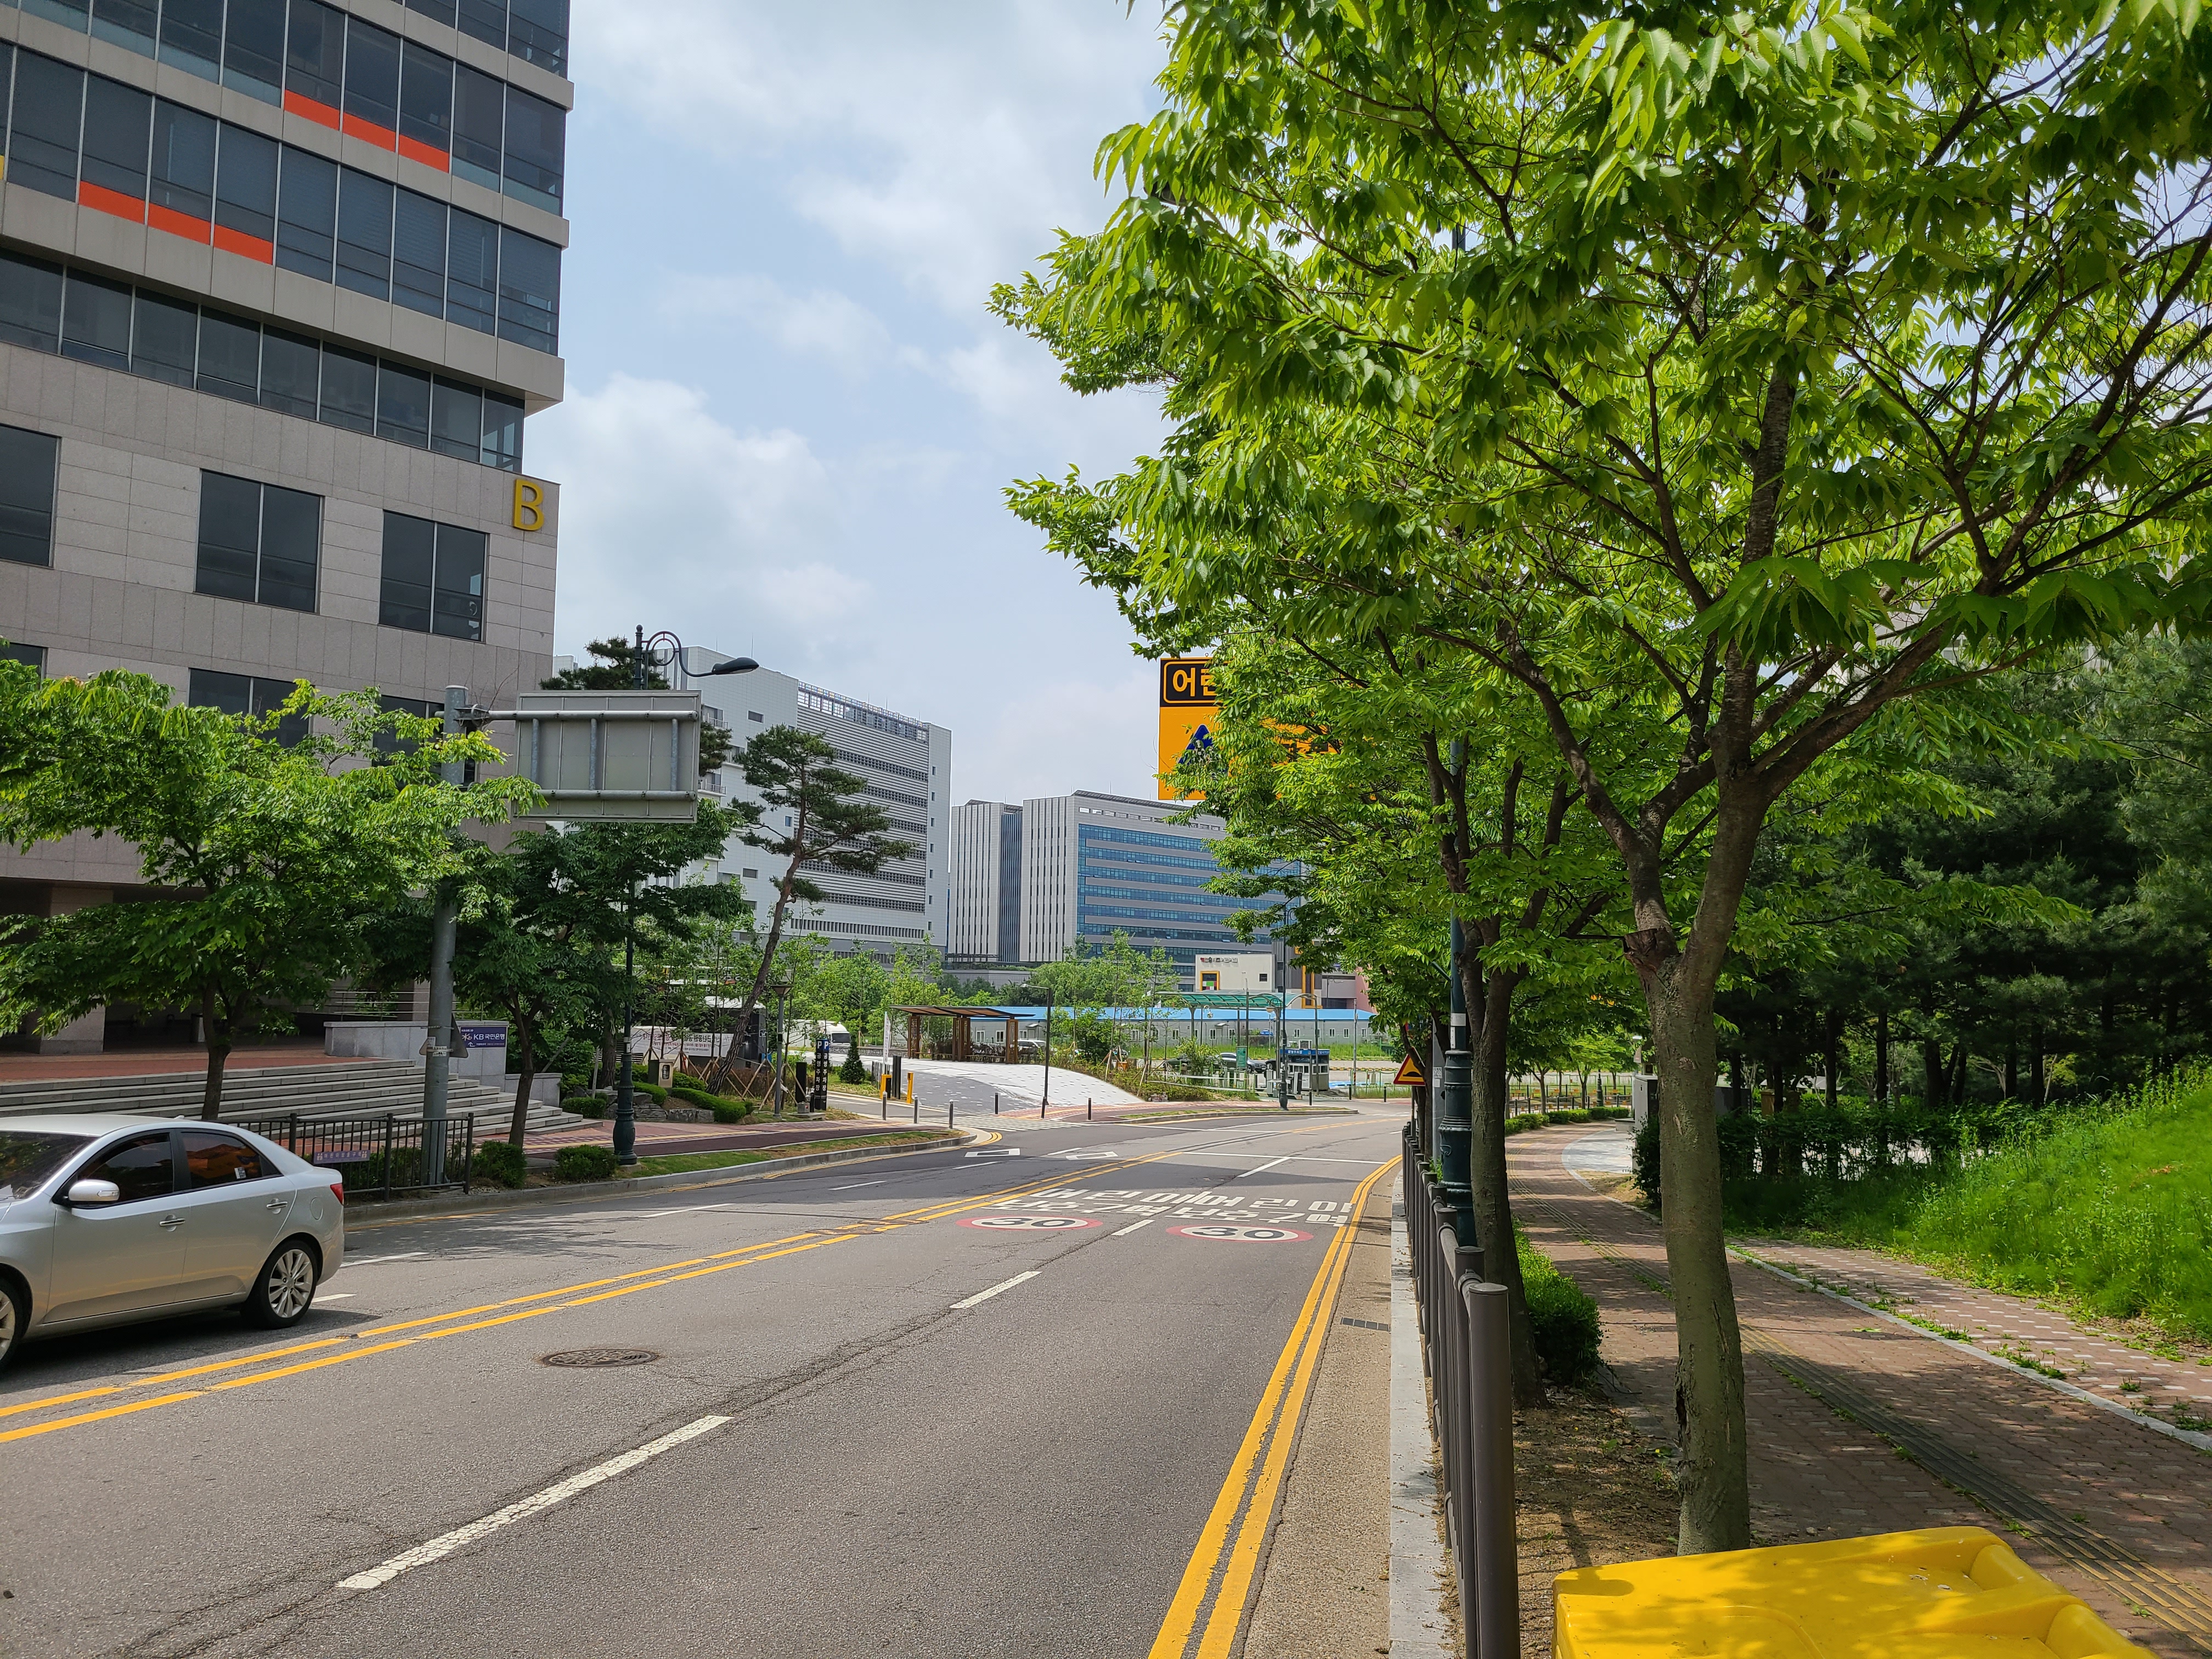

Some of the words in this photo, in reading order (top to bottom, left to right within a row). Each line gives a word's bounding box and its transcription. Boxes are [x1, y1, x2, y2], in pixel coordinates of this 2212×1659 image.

[514, 479, 545, 531] B
[1029, 1188, 1195, 1204] 어린이
[1193, 1195, 1353, 1213] 어린이
[981, 1199, 1172, 1216] 보호구역
[981, 1217, 1076, 1227] 30
[1164, 1207, 1348, 1227] 보호구역
[1192, 1227, 1285, 1239] 30
